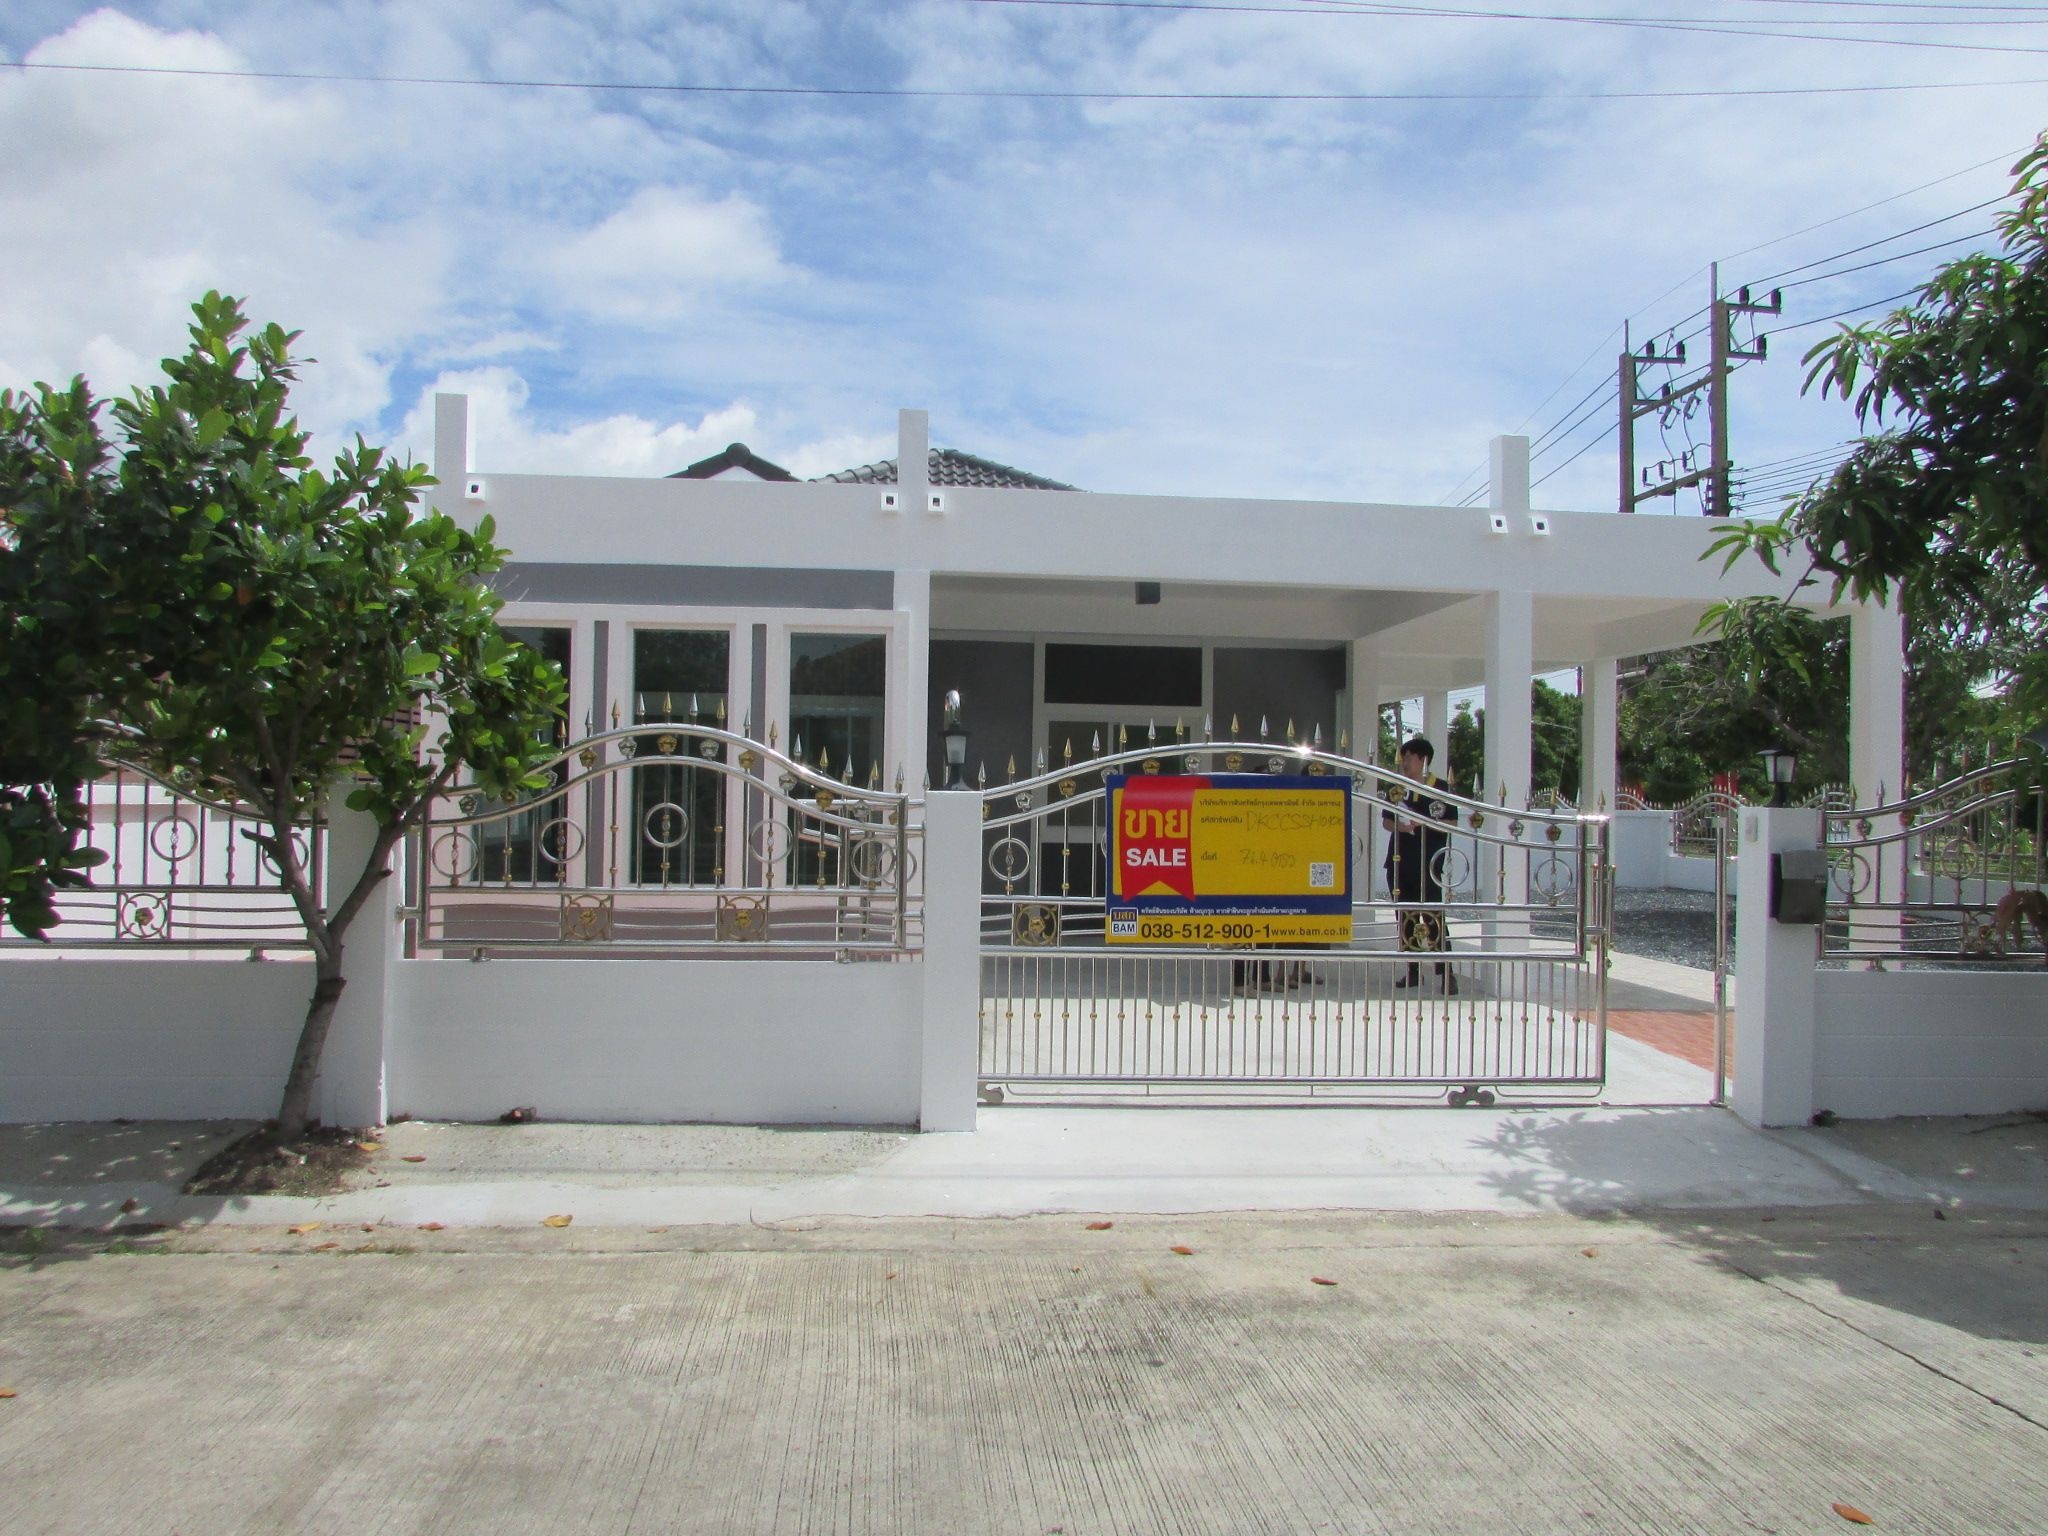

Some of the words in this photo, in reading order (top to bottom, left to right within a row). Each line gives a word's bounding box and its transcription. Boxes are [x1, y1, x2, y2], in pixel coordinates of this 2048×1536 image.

[1125, 809, 1188, 838] ขาย
[1126, 848, 1186, 867] SALE
[1113, 923, 1135, 933] BAM
[1141, 923, 1270, 938] 038-512-900-1
[1271, 926, 1349, 936] www.bam.co.th
